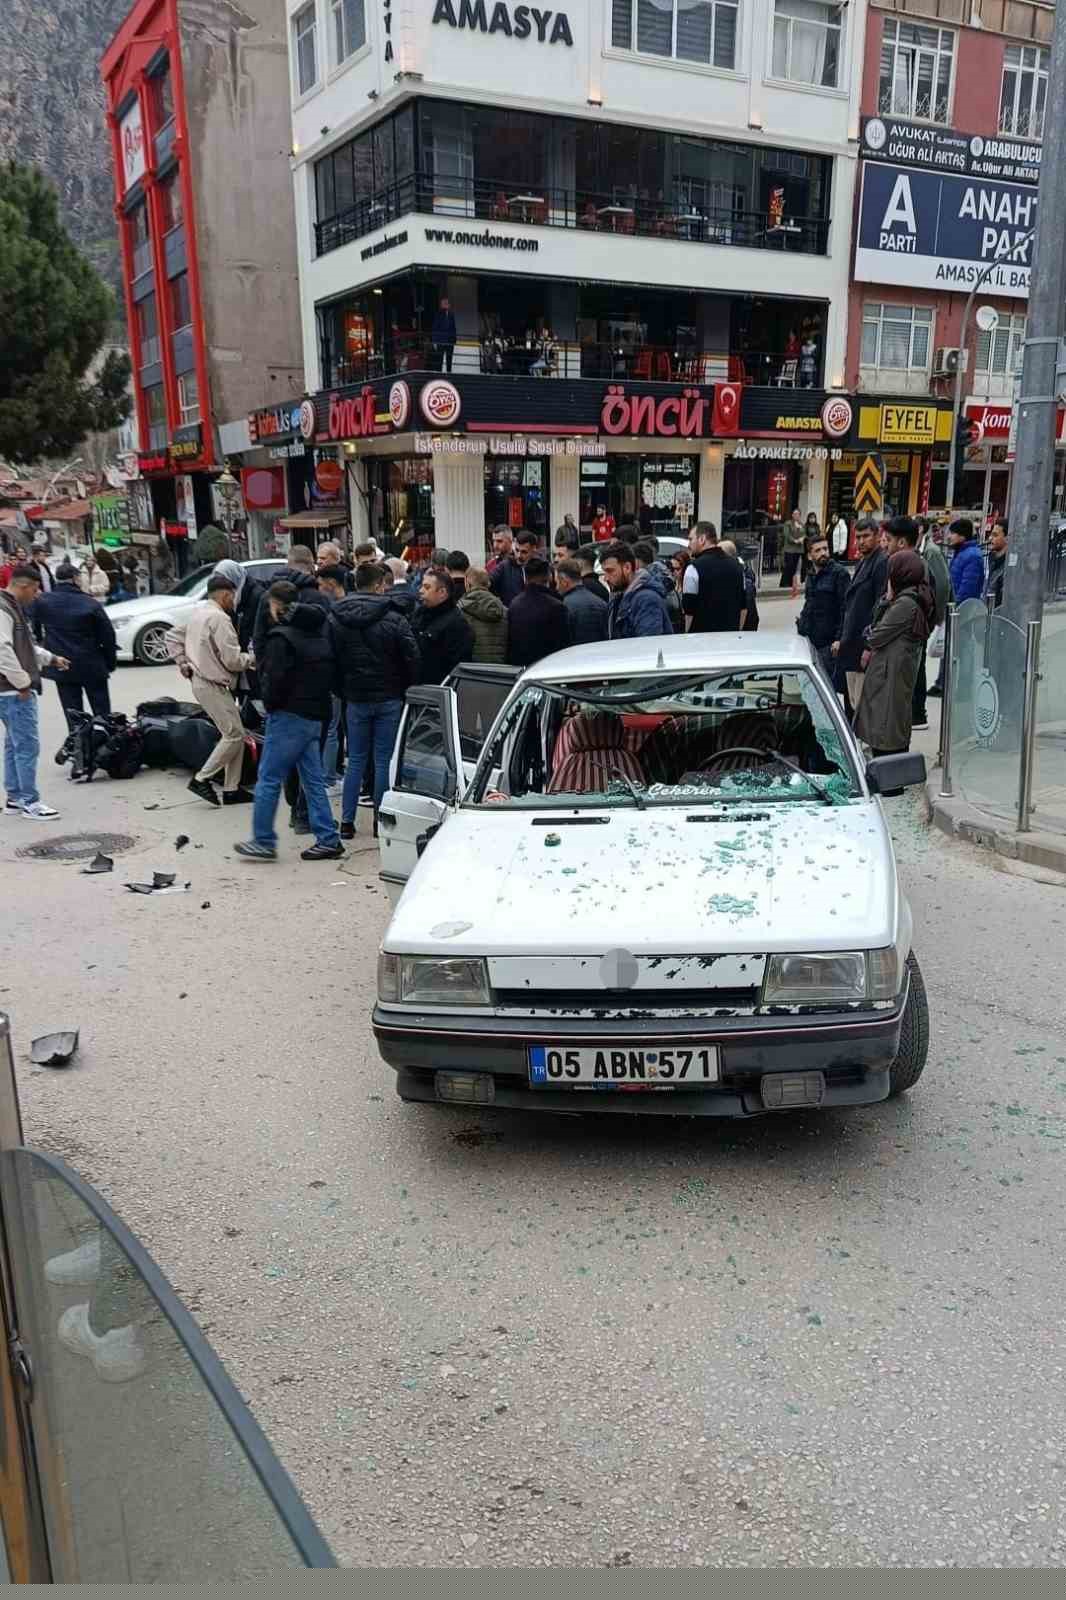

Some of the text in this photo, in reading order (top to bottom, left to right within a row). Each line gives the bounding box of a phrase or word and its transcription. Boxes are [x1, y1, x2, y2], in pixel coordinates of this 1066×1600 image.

[432, 0, 573, 46] AMASYA
[890, 125, 937, 144] AVUKAT
[889, 142, 916, 161] UĞUR
[917, 145, 934, 163] ALİ
[935, 150, 966, 170] AKTAŞ
[984, 141, 1042, 163] ARABULUCU
[881, 174, 917, 233] A
[958, 187, 1037, 227] ANAH
[424, 227, 540, 253] www.oncudoner.com
[981, 227, 1035, 262] PAR
[936, 263, 992, 286] AMASYA
[996, 266, 1006, 287] İL
[885, 409, 932, 431] EYFEL
[734, 446, 758, 459] ALO
[760, 447, 792, 460] PAKET
[793, 448, 813, 460] 270
[533, 1051, 710, 1079] TR 05 ABN 571
